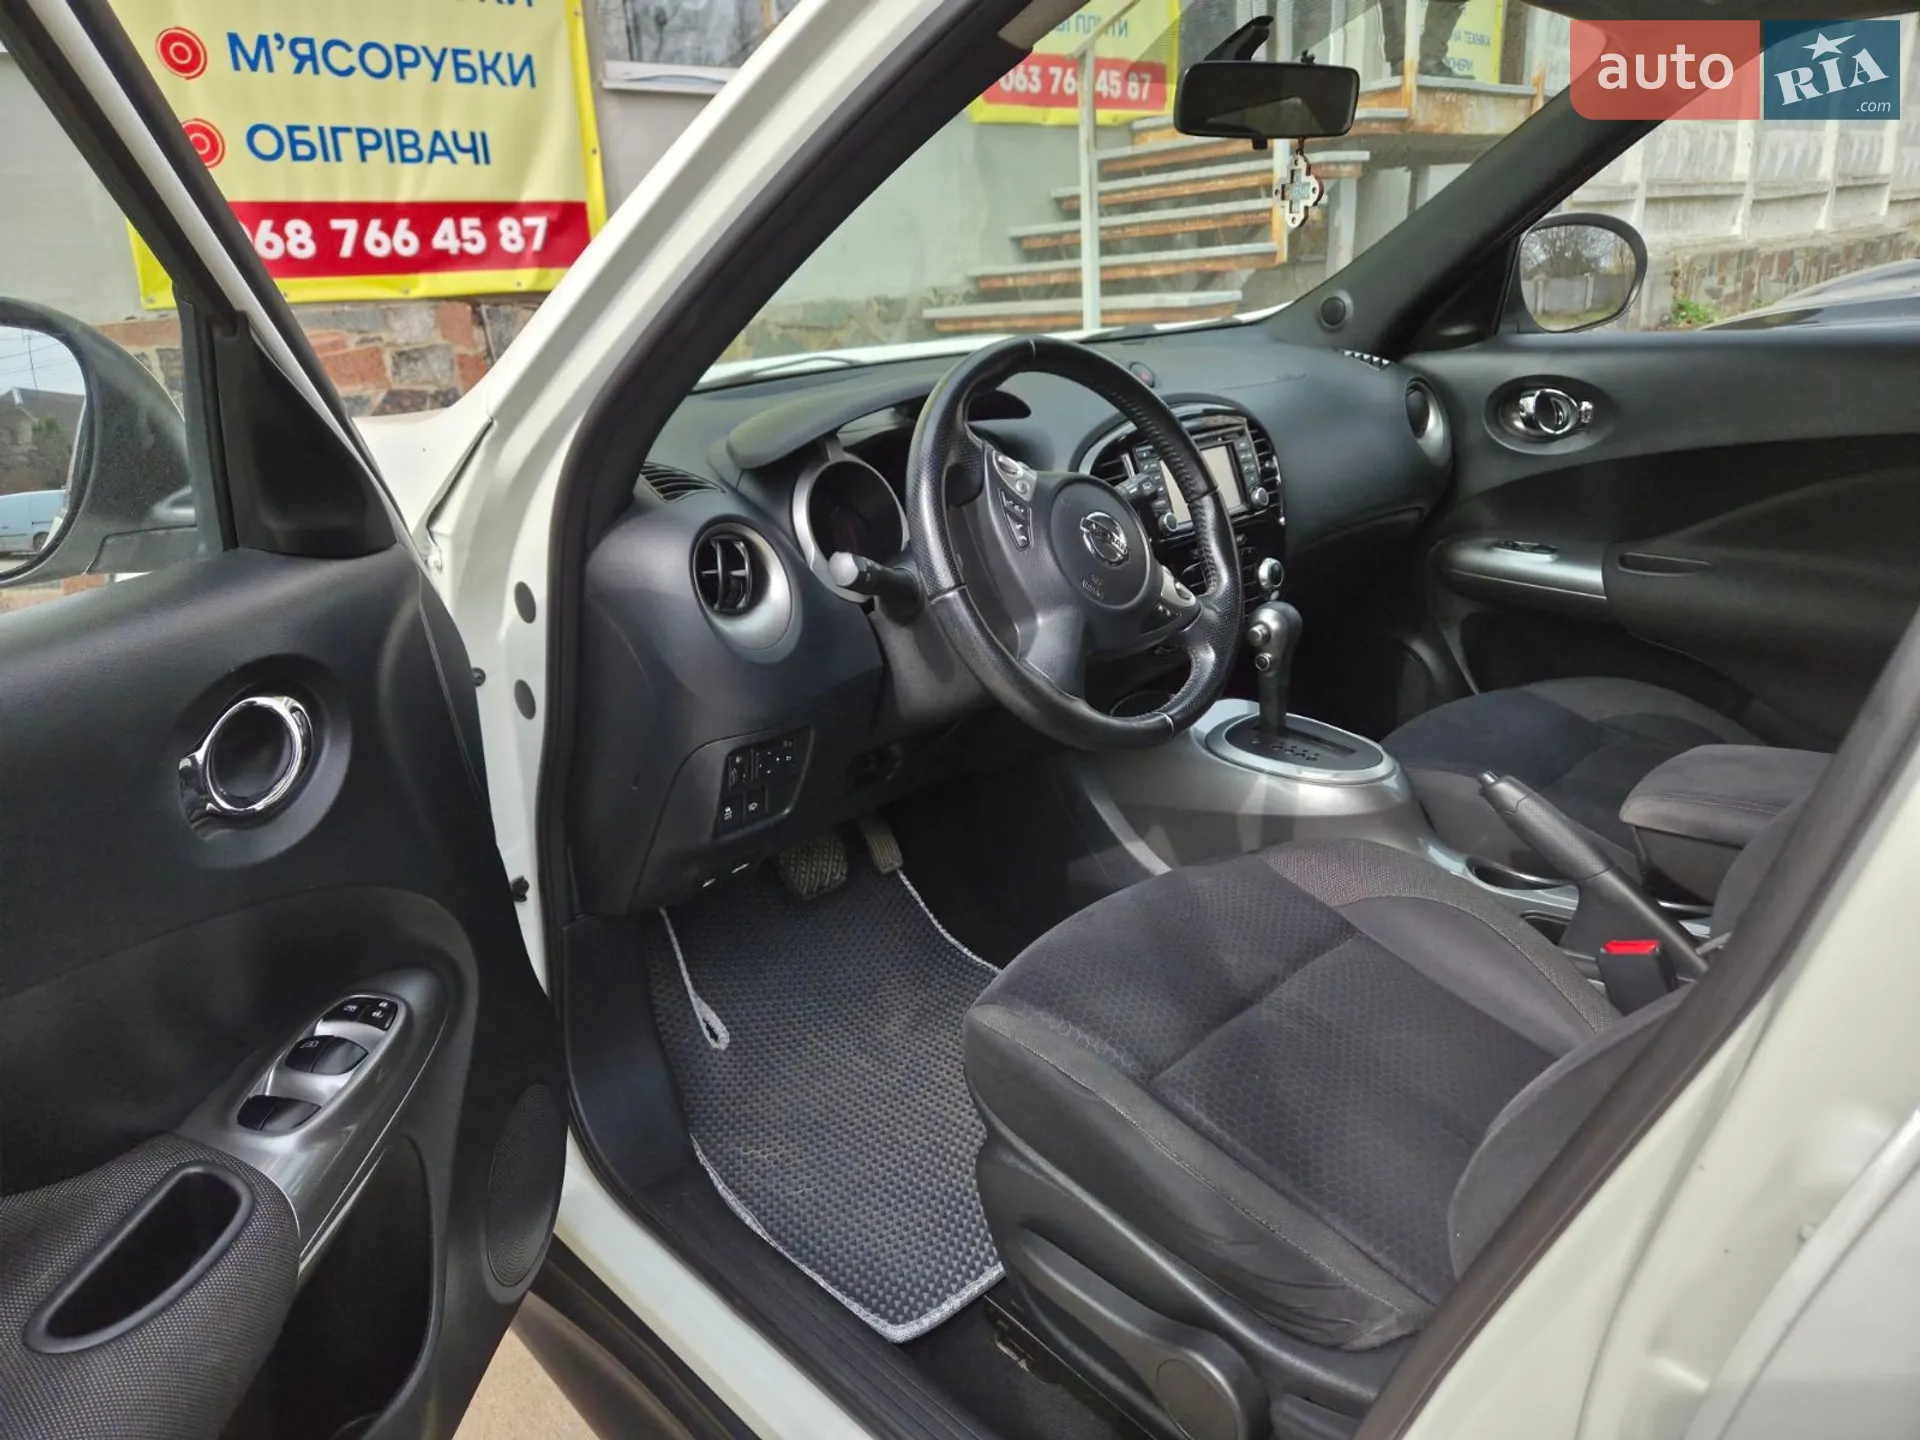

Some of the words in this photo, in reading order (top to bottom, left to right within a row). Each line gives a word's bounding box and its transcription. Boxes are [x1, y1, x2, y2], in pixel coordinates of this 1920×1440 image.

[1095, 69, 1122, 99] 45
[1127, 72, 1152, 101] 87
[246, 123, 492, 166] ОБІГРІВАЧІ
[240, 218, 316, 260] 68
[330, 218, 420, 258] 766
[432, 216, 487, 255] 45
[498, 216, 547, 253] 87
